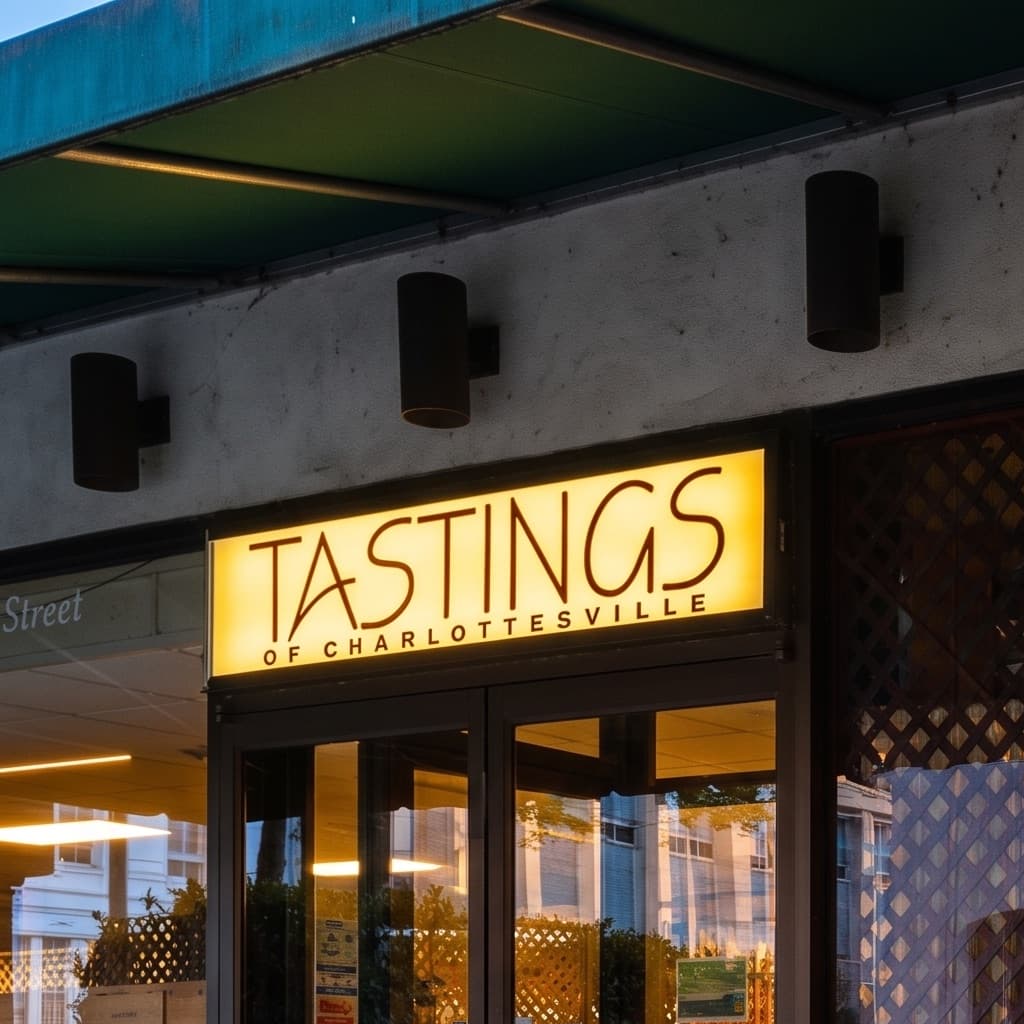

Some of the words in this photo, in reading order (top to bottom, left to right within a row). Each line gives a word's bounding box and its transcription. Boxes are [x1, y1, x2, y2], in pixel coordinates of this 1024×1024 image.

[248, 466, 725, 643] TASTINGS
[2, 587, 84, 633] Street
[262, 644, 301, 667] OF
[323, 593, 706, 659] CHARLOTTESVILLE
